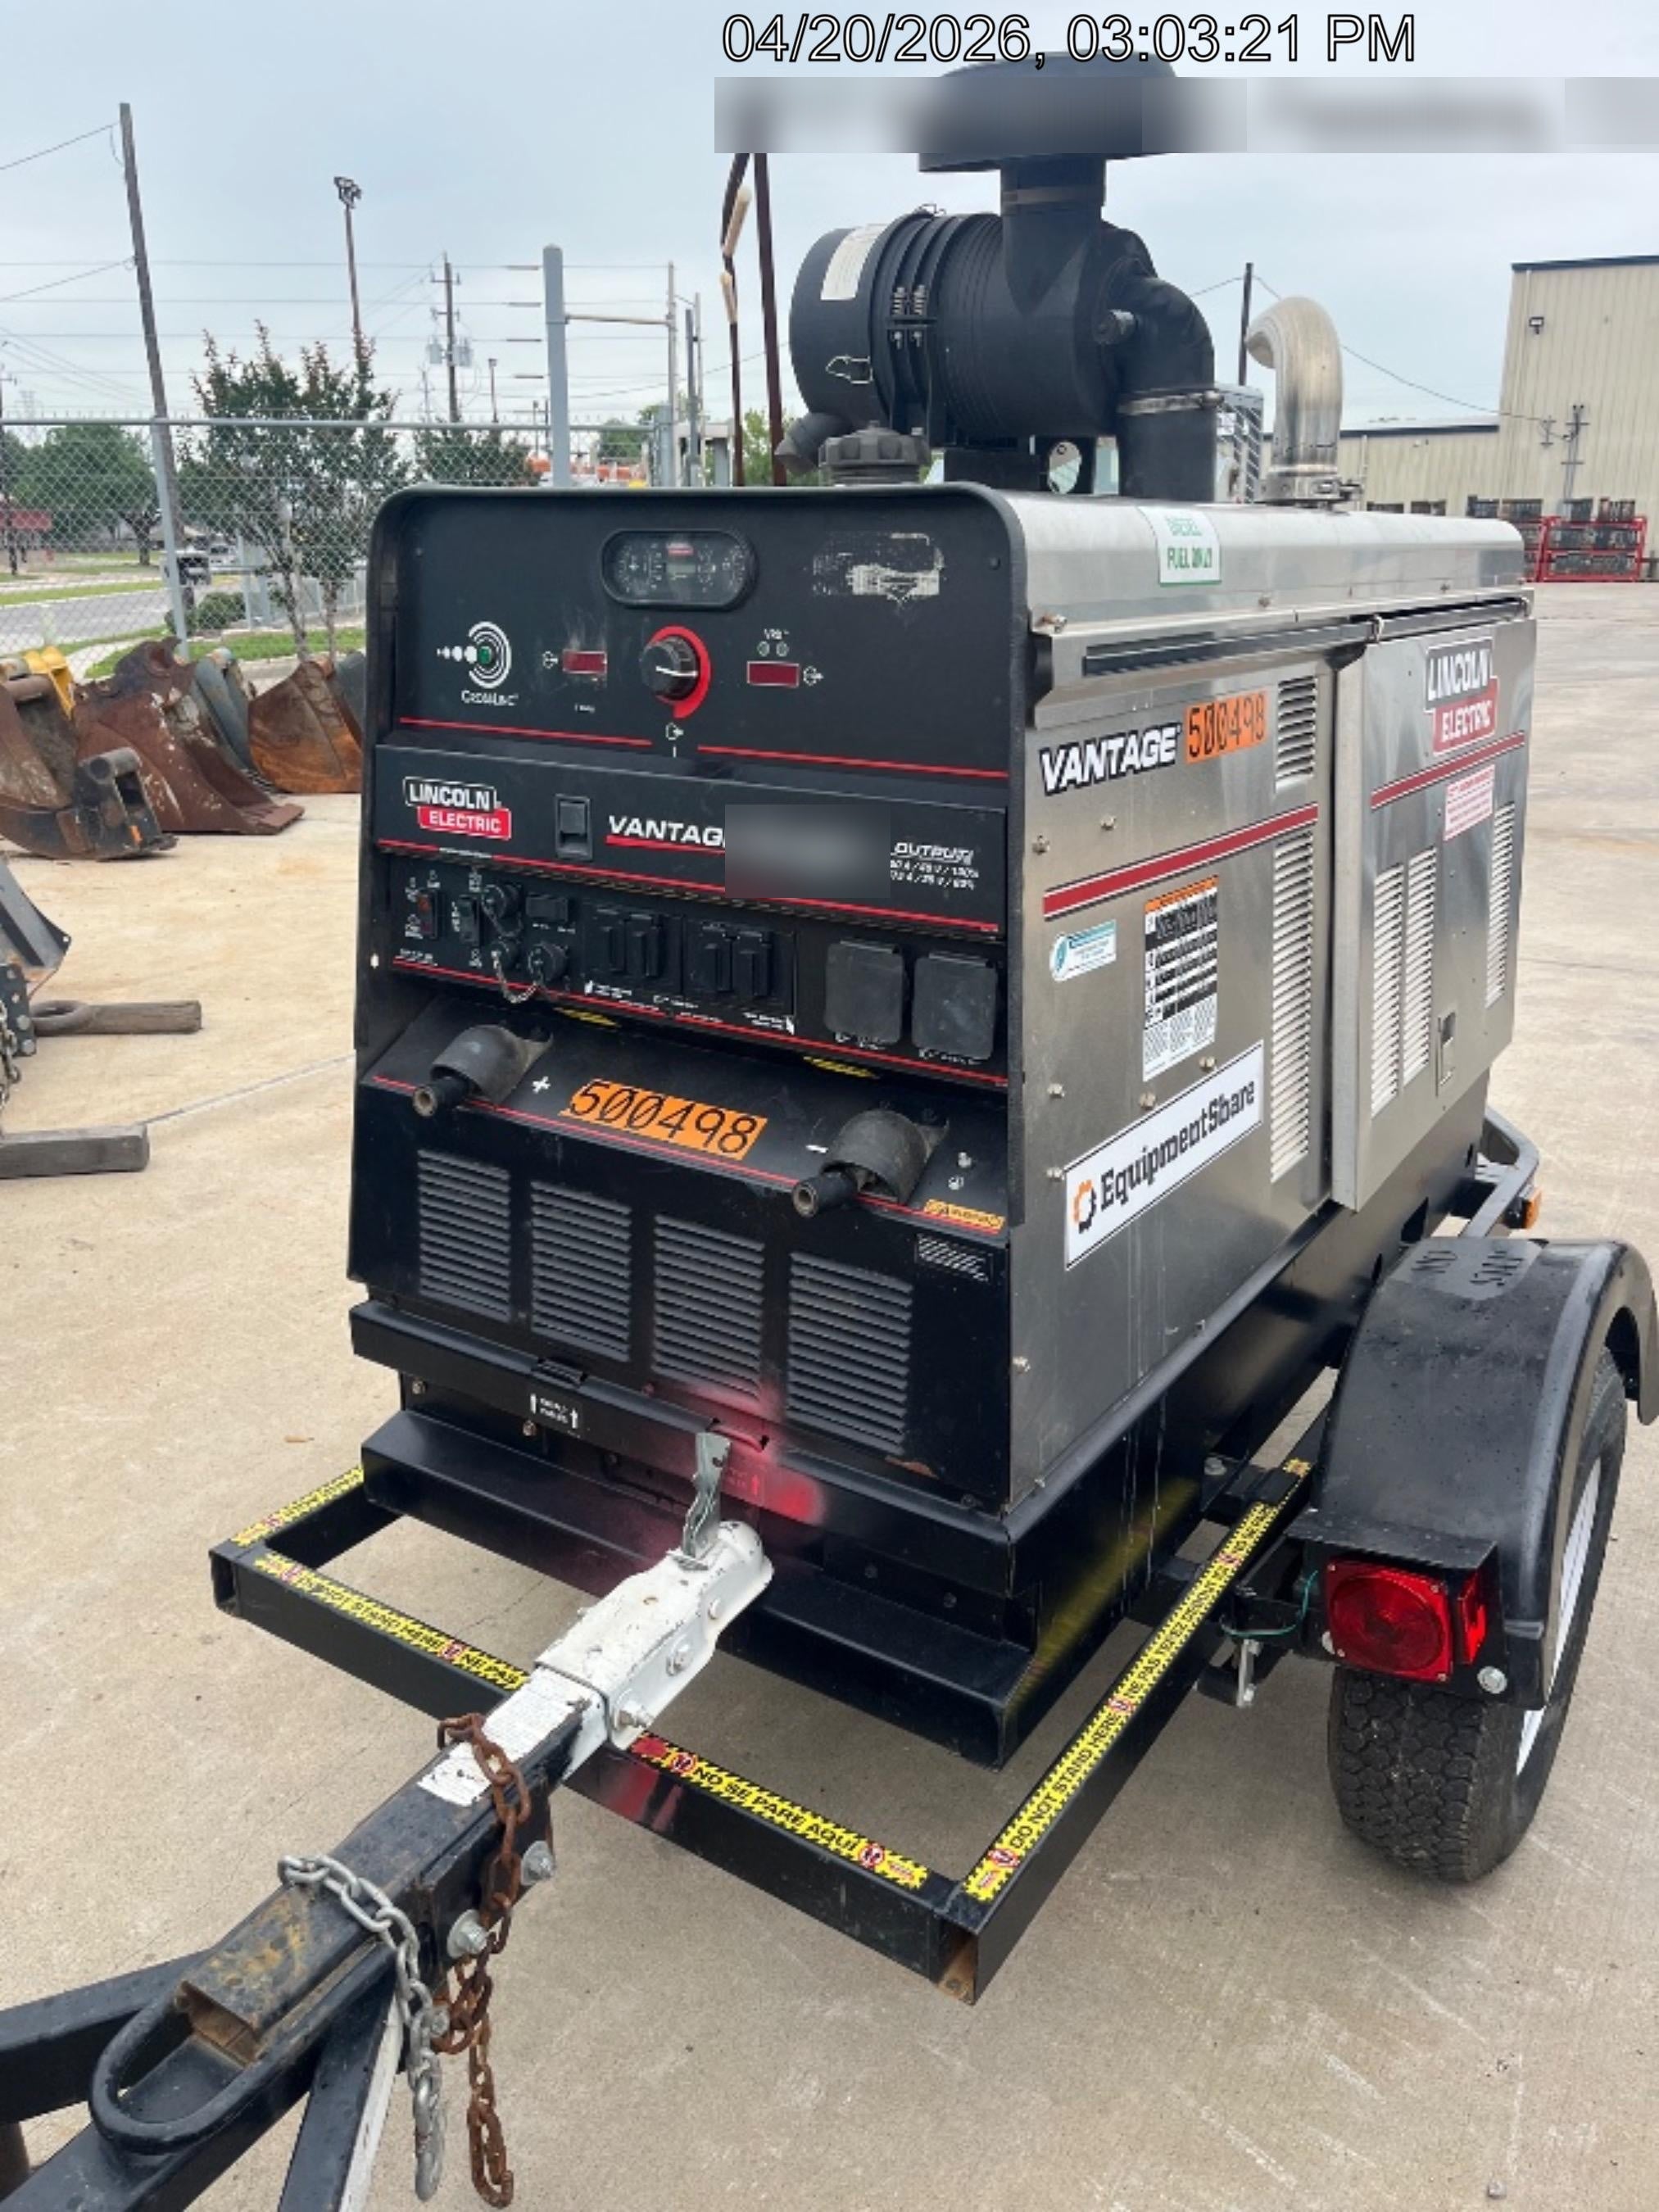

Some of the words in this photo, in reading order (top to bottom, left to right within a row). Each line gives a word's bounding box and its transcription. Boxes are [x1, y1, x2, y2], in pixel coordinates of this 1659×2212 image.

[1428, 649, 1490, 701] LINCOLN
[1188, 694, 1266, 759] 500498
[1441, 700, 1493, 743] ELECTRIC
[1040, 724, 1181, 795] VANTAGE
[410, 783, 491, 811] LINCOLN
[428, 809, 502, 833] ELECTRIC
[608, 814, 726, 848] VANTAG
[570, 1080, 759, 1154] 500498
[1100, 1081, 1255, 1211] EquipmentShare
[351, 1601, 401, 1630] STAND
[696, 1766, 724, 1786] NO
[724, 1782, 752, 1801] SE
[752, 1795, 807, 1829] PARE
[807, 1821, 860, 1852] AQUI
[1009, 1824, 1034, 1850] DO
[1027, 1792, 1057, 1825] NOT
[1052, 1747, 1093, 1794] STAND
[1089, 1712, 1122, 1748] HERE
